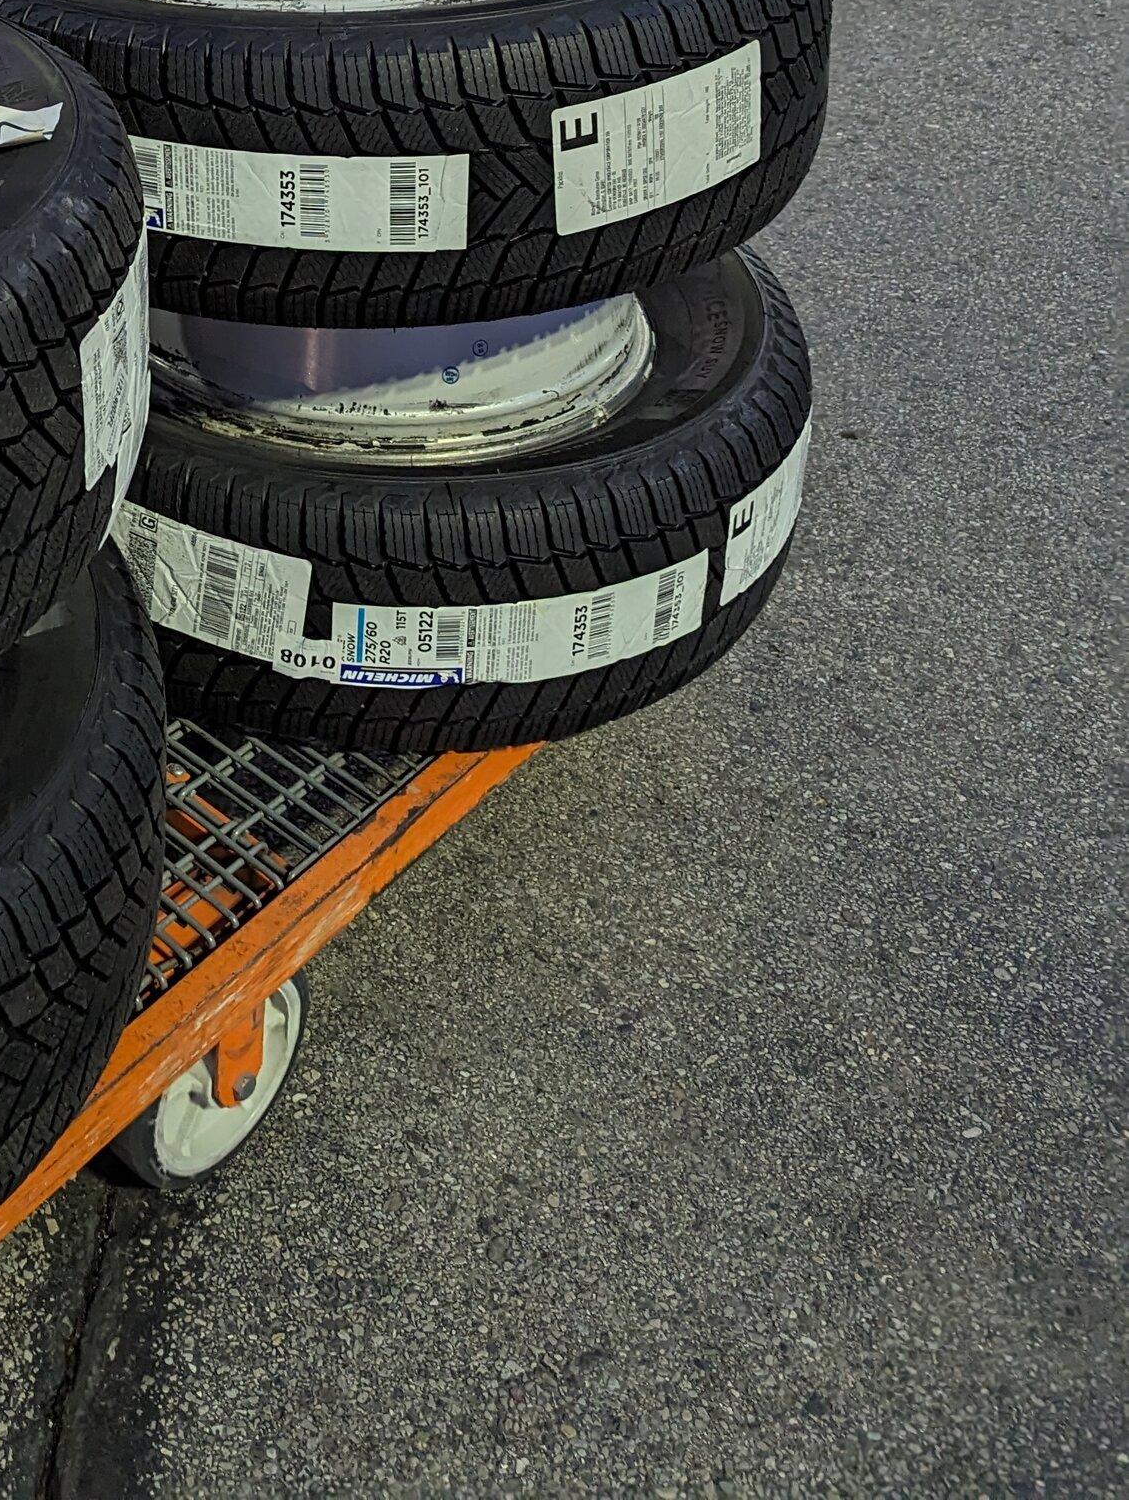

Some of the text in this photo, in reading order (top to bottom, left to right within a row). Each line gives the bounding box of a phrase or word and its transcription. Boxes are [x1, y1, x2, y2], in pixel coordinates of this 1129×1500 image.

[560, 112, 598, 152] E
[166, 191, 174, 223] WARNING
[280, 170, 296, 227] 174353
[418, 168, 432, 239] 174353_101
[141, 516, 156, 530] G
[731, 500, 755, 540] E
[396, 609, 407, 629] 115T
[671, 570, 685, 631] 174353_101
[347, 633, 357, 663] SNOW
[365, 621, 378, 664] 275/60
[418, 610, 434, 653] 05122
[572, 605, 588, 657] 174353
[379, 640, 391, 664] R20
[342, 669, 435, 683] MICHELIN
